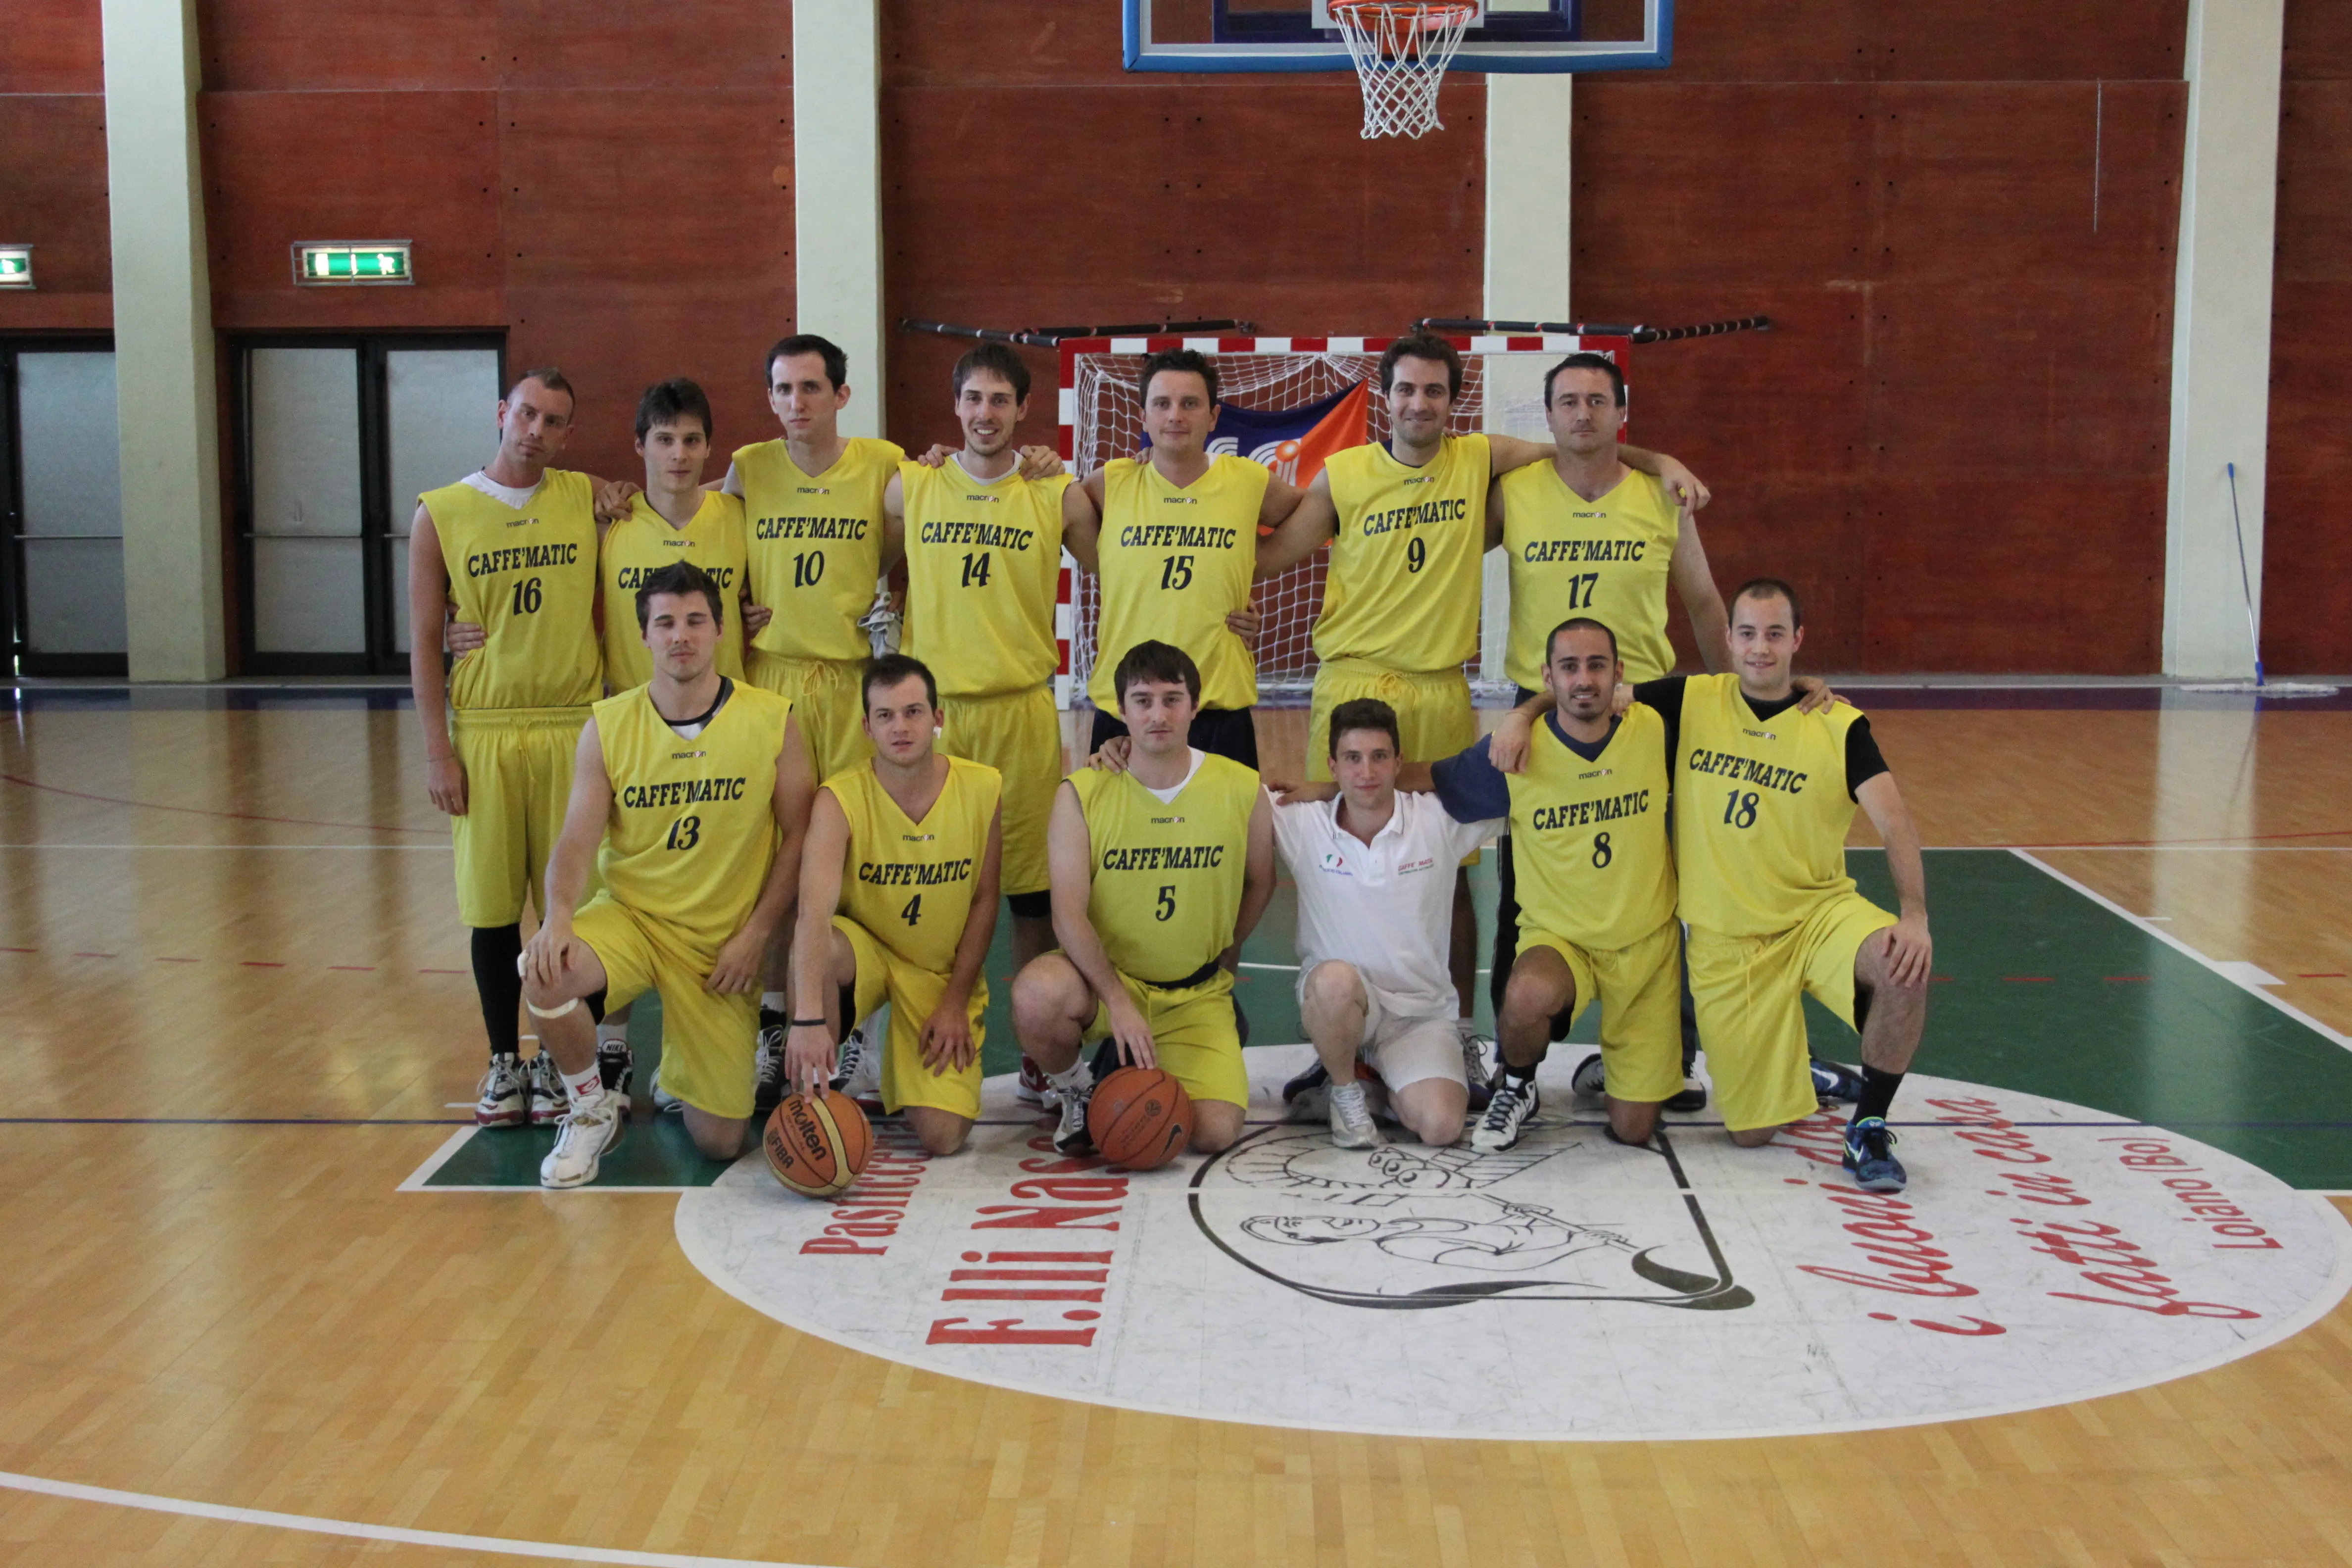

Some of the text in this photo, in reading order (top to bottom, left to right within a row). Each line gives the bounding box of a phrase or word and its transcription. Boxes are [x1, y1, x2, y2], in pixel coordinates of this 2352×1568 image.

[1404, 476, 1435, 486] macron
[506, 518, 539, 528] macron
[756, 517, 868, 540] CAFFE'MATIC
[1364, 498, 1466, 537] CAFFE'MATIC
[922, 522, 1033, 551] CAFFE'MATIC
[1121, 525, 1236, 549] CAFFE'MATIC
[1524, 540, 1646, 563] CAFFE'MATIC
[468, 543, 577, 578] CAFFE'MATIC
[793, 550, 825, 588] 10
[962, 552, 990, 588] 14
[1161, 555, 1194, 590] 15
[1408, 537, 1425, 573] 9
[618, 567, 733, 589] CAFTIC
[1568, 572, 1599, 610] 17
[513, 577, 541, 616] 16
[1742, 728, 1776, 740] macron
[672, 751, 706, 759] macron
[1689, 748, 1808, 794] CAFFE'MATIC
[1578, 769, 1612, 780] macron
[624, 777, 746, 808] CAFFE'MATIC
[1533, 789, 1649, 831] CAFFE'MATIC
[1724, 789, 1759, 829] 18
[667, 815, 700, 850] 13
[1103, 845, 1224, 870] CAFFE'MATIC
[1592, 832, 1612, 869] 8
[859, 858, 972, 885] CAFFE'MATIC
[901, 894, 921, 927] 4
[1155, 885, 1176, 922] 5
[788, 1099, 827, 1161] molten
[771, 1136, 794, 1169] FIBA
[1984, 1172, 2092, 1206] in
[2161, 1178, 2284, 1249] Loiano
[926, 1250, 1114, 1347] F.lli
